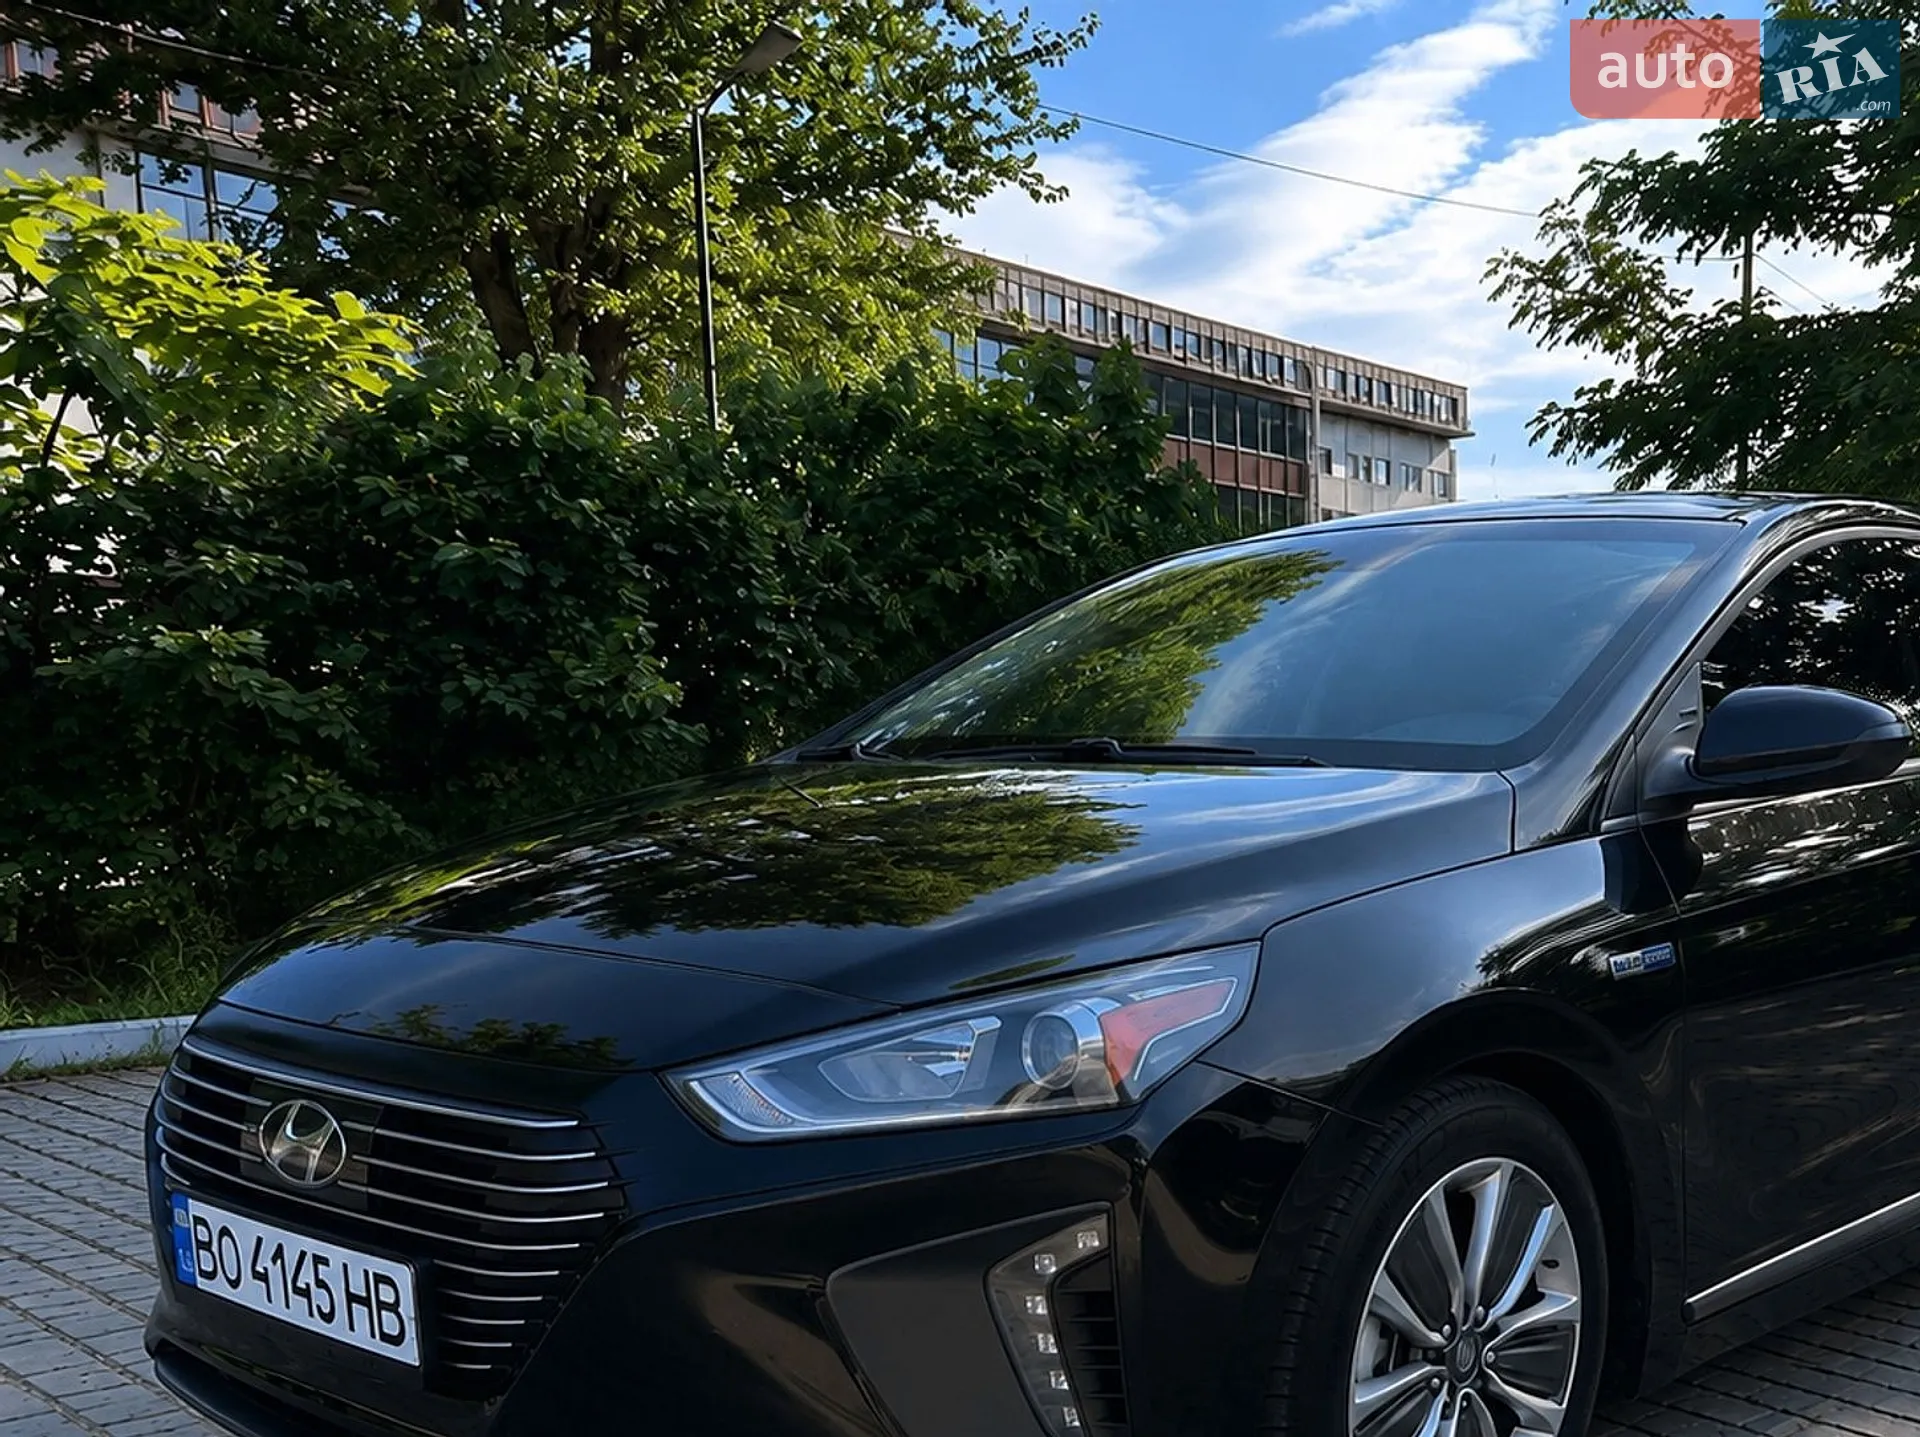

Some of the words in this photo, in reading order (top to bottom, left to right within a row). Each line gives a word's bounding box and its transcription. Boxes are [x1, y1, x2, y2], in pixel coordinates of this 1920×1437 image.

[190, 1213, 243, 1291] BO
[251, 1234, 337, 1326] 4145
[342, 1262, 406, 1348] HB
